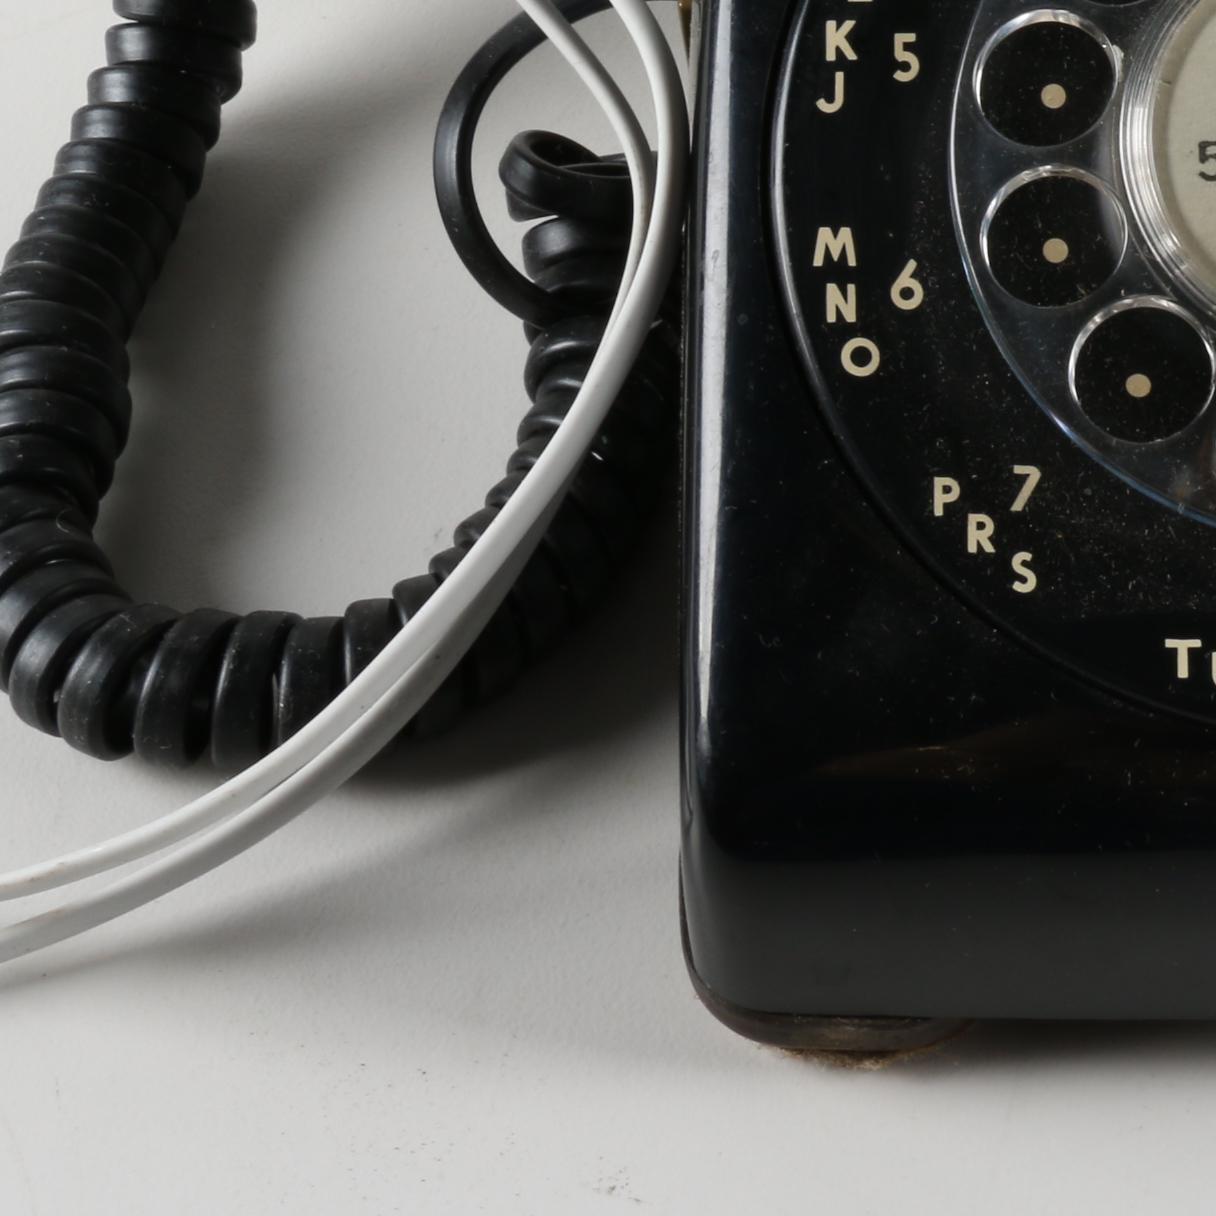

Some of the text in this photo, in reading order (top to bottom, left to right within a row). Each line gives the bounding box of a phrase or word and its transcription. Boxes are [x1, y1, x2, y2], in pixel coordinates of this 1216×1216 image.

[893, 33, 920, 82] 5
[890, 259, 924, 310] 6
[1011, 465, 1041, 517] 7
[933, 477, 1037, 593] PRS
